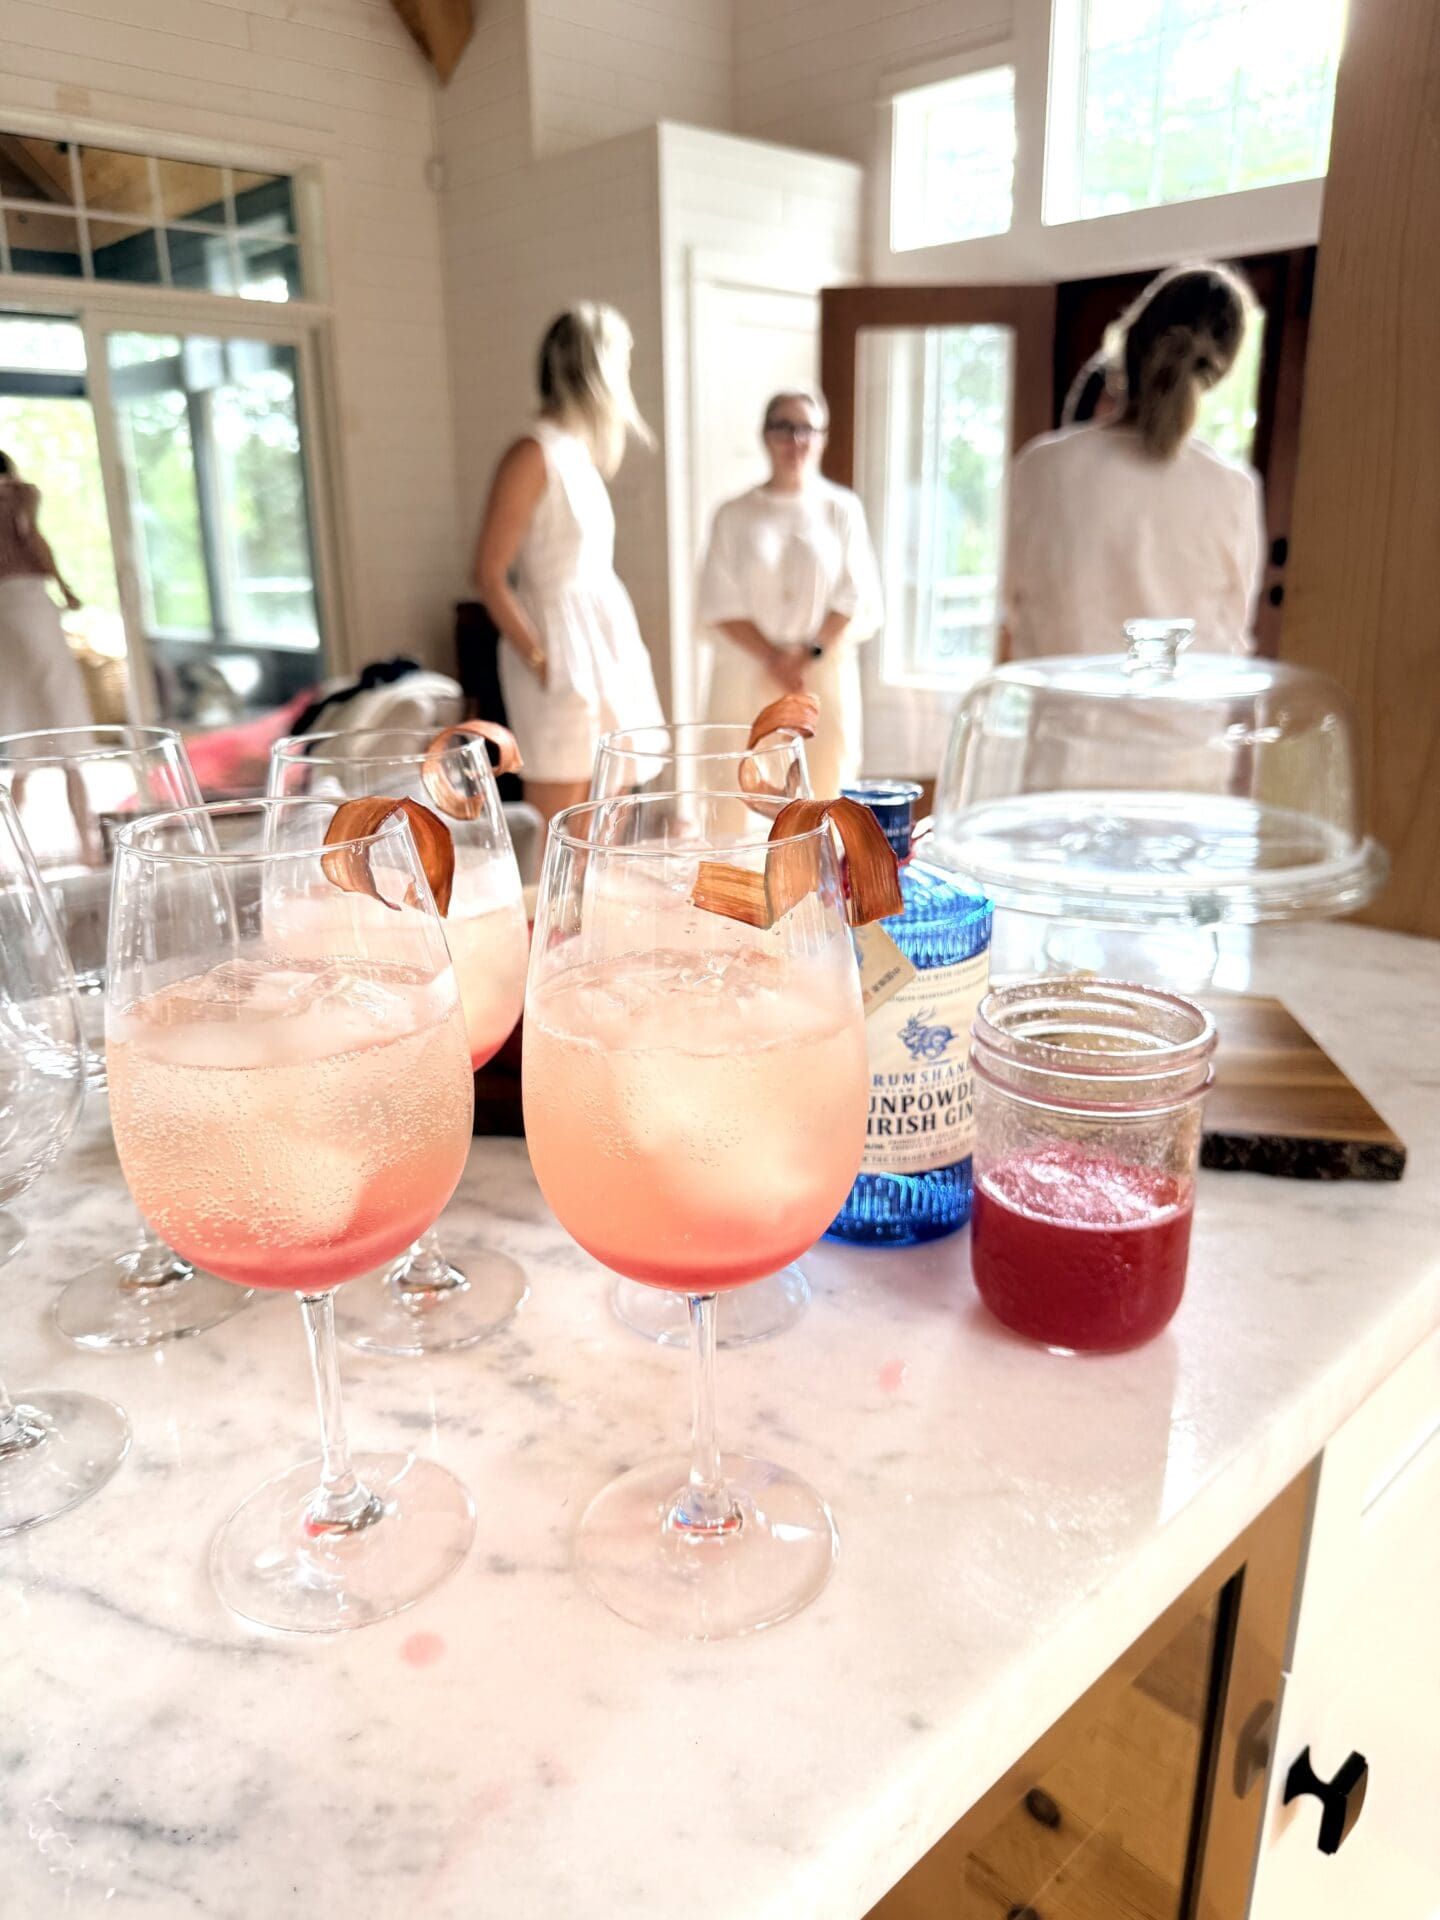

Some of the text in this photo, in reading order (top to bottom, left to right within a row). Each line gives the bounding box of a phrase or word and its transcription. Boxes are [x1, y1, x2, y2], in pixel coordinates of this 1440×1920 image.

[873, 1062, 970, 1087] RUMSHAN
[867, 1100, 973, 1135] IRISH GIN
